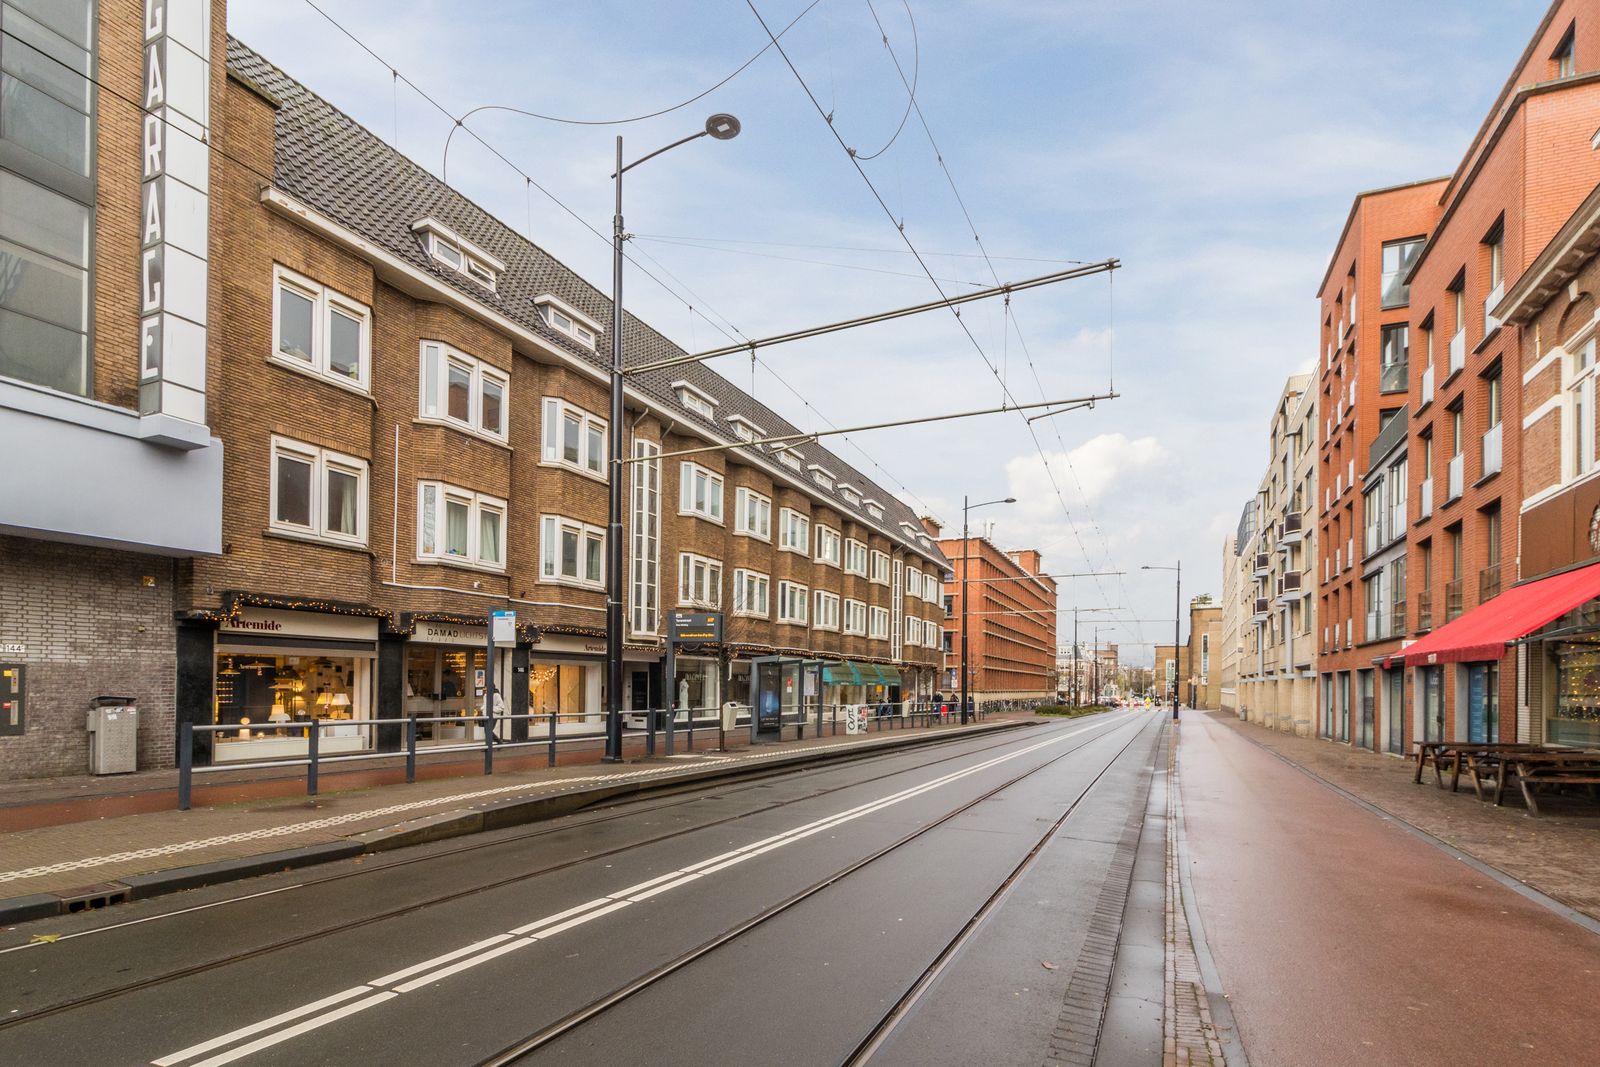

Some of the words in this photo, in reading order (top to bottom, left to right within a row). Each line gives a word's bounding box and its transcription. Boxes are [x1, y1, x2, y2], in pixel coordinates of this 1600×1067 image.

[142, 0, 164, 381] GARAGE
[224, 619, 282, 631] Artemide
[427, 628, 459, 638] DAMAD
